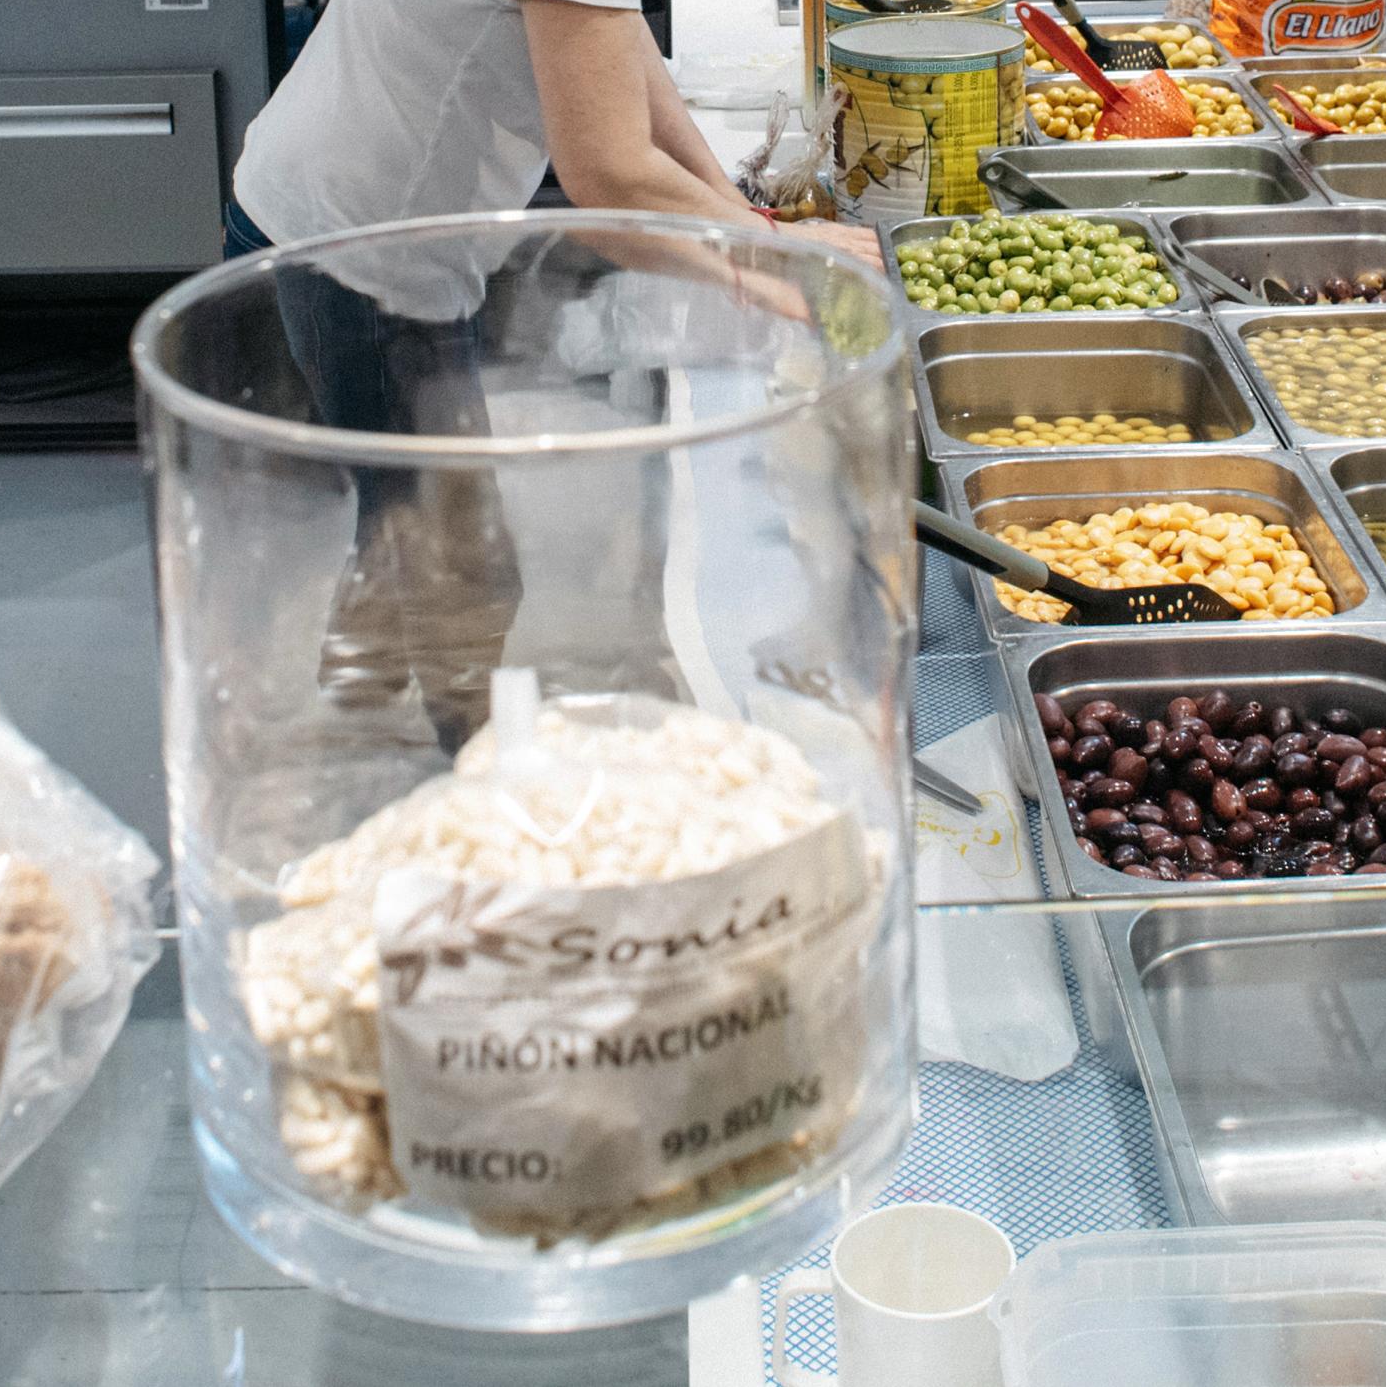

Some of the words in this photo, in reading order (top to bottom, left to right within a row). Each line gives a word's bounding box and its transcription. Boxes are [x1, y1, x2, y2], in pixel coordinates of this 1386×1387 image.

[1284, 12, 1314, 39] El
[1315, 7, 1382, 40] Llano
[549, 894, 793, 966] Sonia
[592, 988, 793, 1071] NACIONAL
